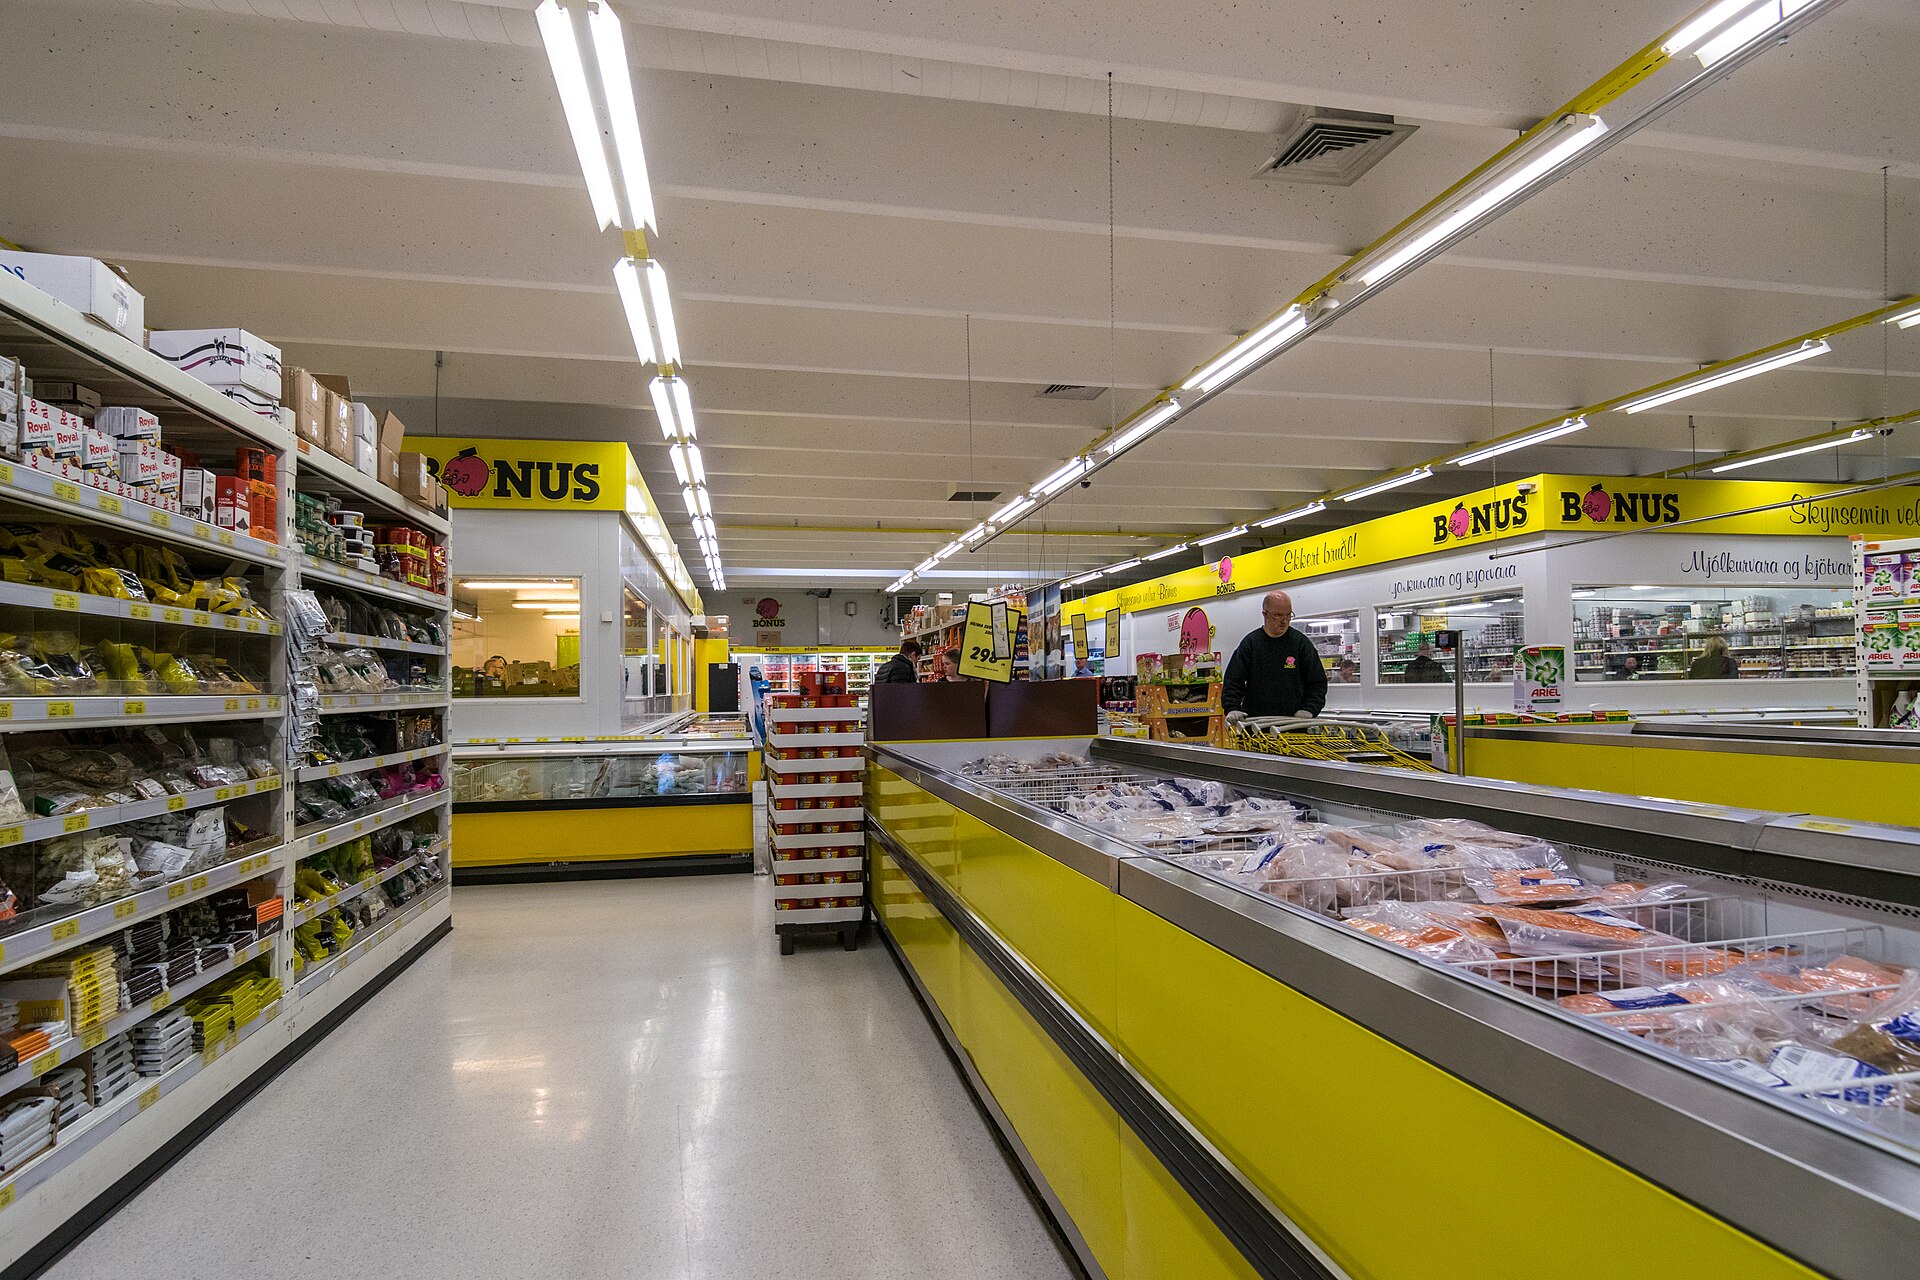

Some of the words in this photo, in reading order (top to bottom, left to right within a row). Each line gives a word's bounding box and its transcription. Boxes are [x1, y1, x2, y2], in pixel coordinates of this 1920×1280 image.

[27, 421, 51, 433] Royal
[138, 416, 156, 427] Royal
[57, 432, 79, 444] Royal
[89, 444, 110, 455] Royal
[140, 463, 158, 473] Royal
[161, 471, 177, 481] Royal
[1790, 494, 1891, 532] Skynsemin
[1283, 547, 1319, 573] Ekkert
[1681, 550, 1778, 579] Mjólkurvara
[1783, 559, 1800, 580] og
[1804, 554, 1854, 580] kjötvar
[752, 617, 786, 628] BÓNUS
[1531, 688, 1561, 697] ARIEL
